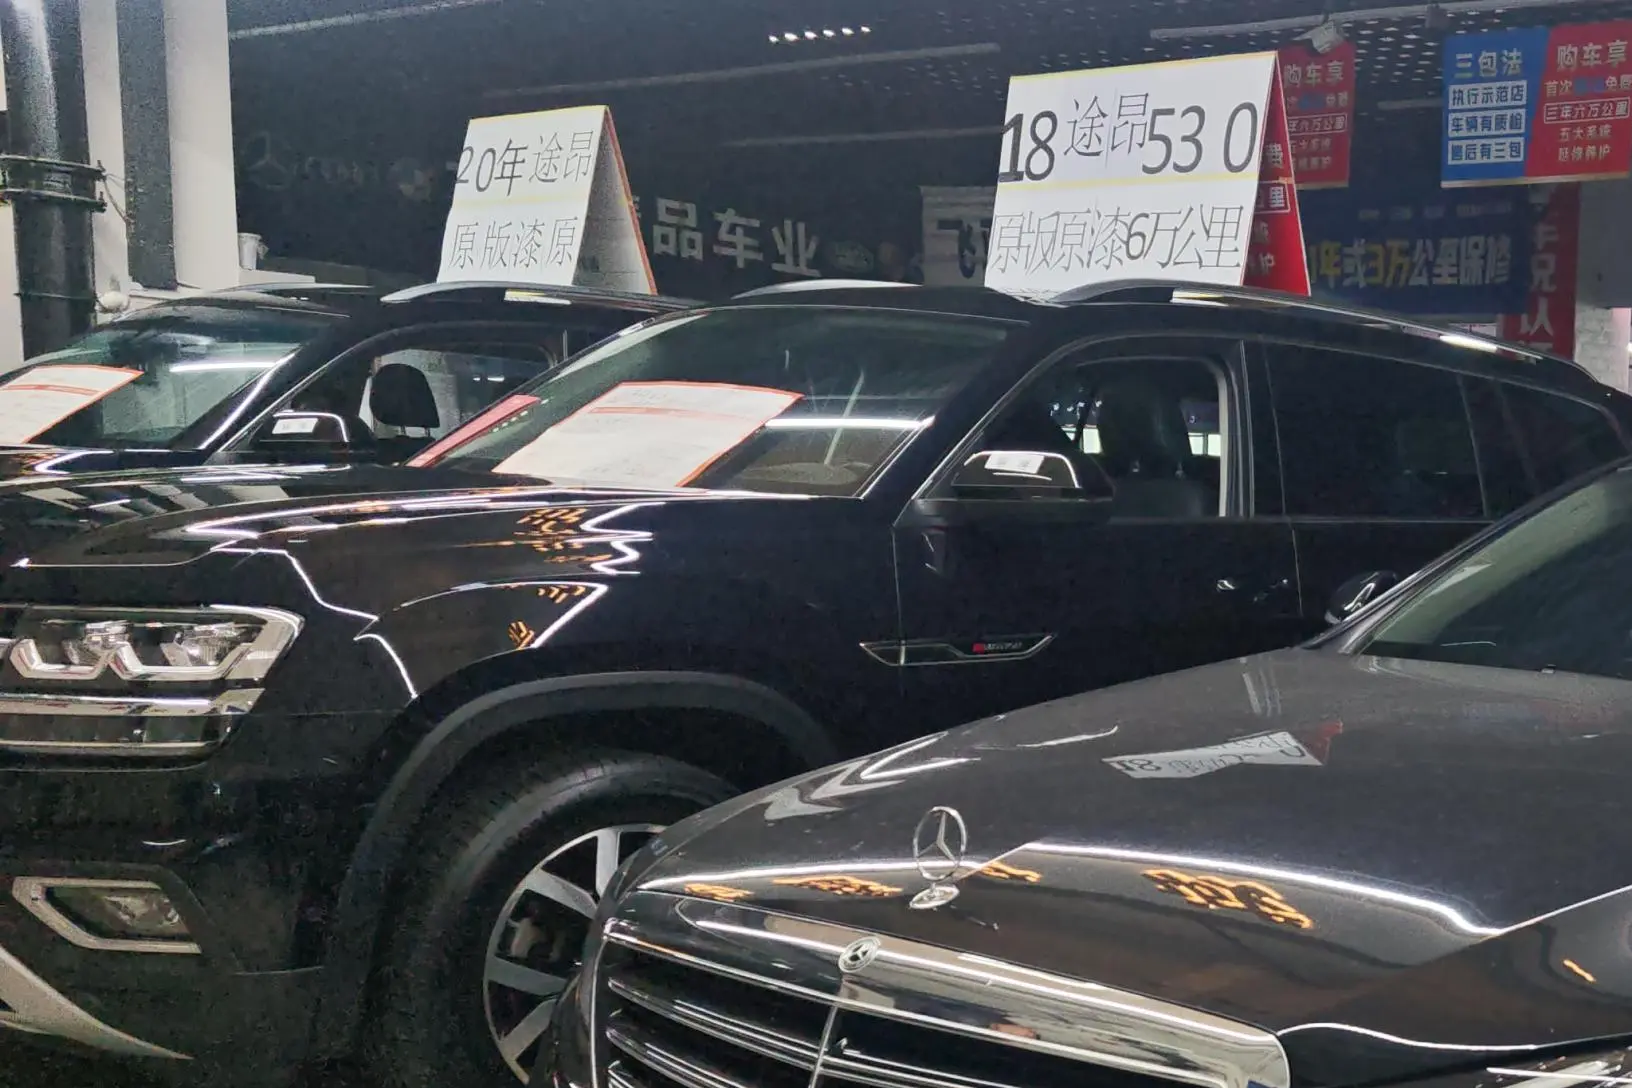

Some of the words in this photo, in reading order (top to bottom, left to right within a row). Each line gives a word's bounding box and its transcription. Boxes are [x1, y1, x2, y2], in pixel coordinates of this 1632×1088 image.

[1455, 48, 1523, 78] 三包法
[1557, 39, 1628, 72] 购车享
[1452, 84, 1525, 106] 执行示范店
[1547, 101, 1628, 120] 三年六万公里
[1559, 124, 1613, 141] 五大系统
[456, 131, 594, 196] 20年途昂
[1451, 141, 1522, 161] 售后有三包
[448, 216, 578, 270] 原版漆原
[631, 196, 820, 277] 品车业
[988, 203, 1244, 275] 原版原漆6万公里
